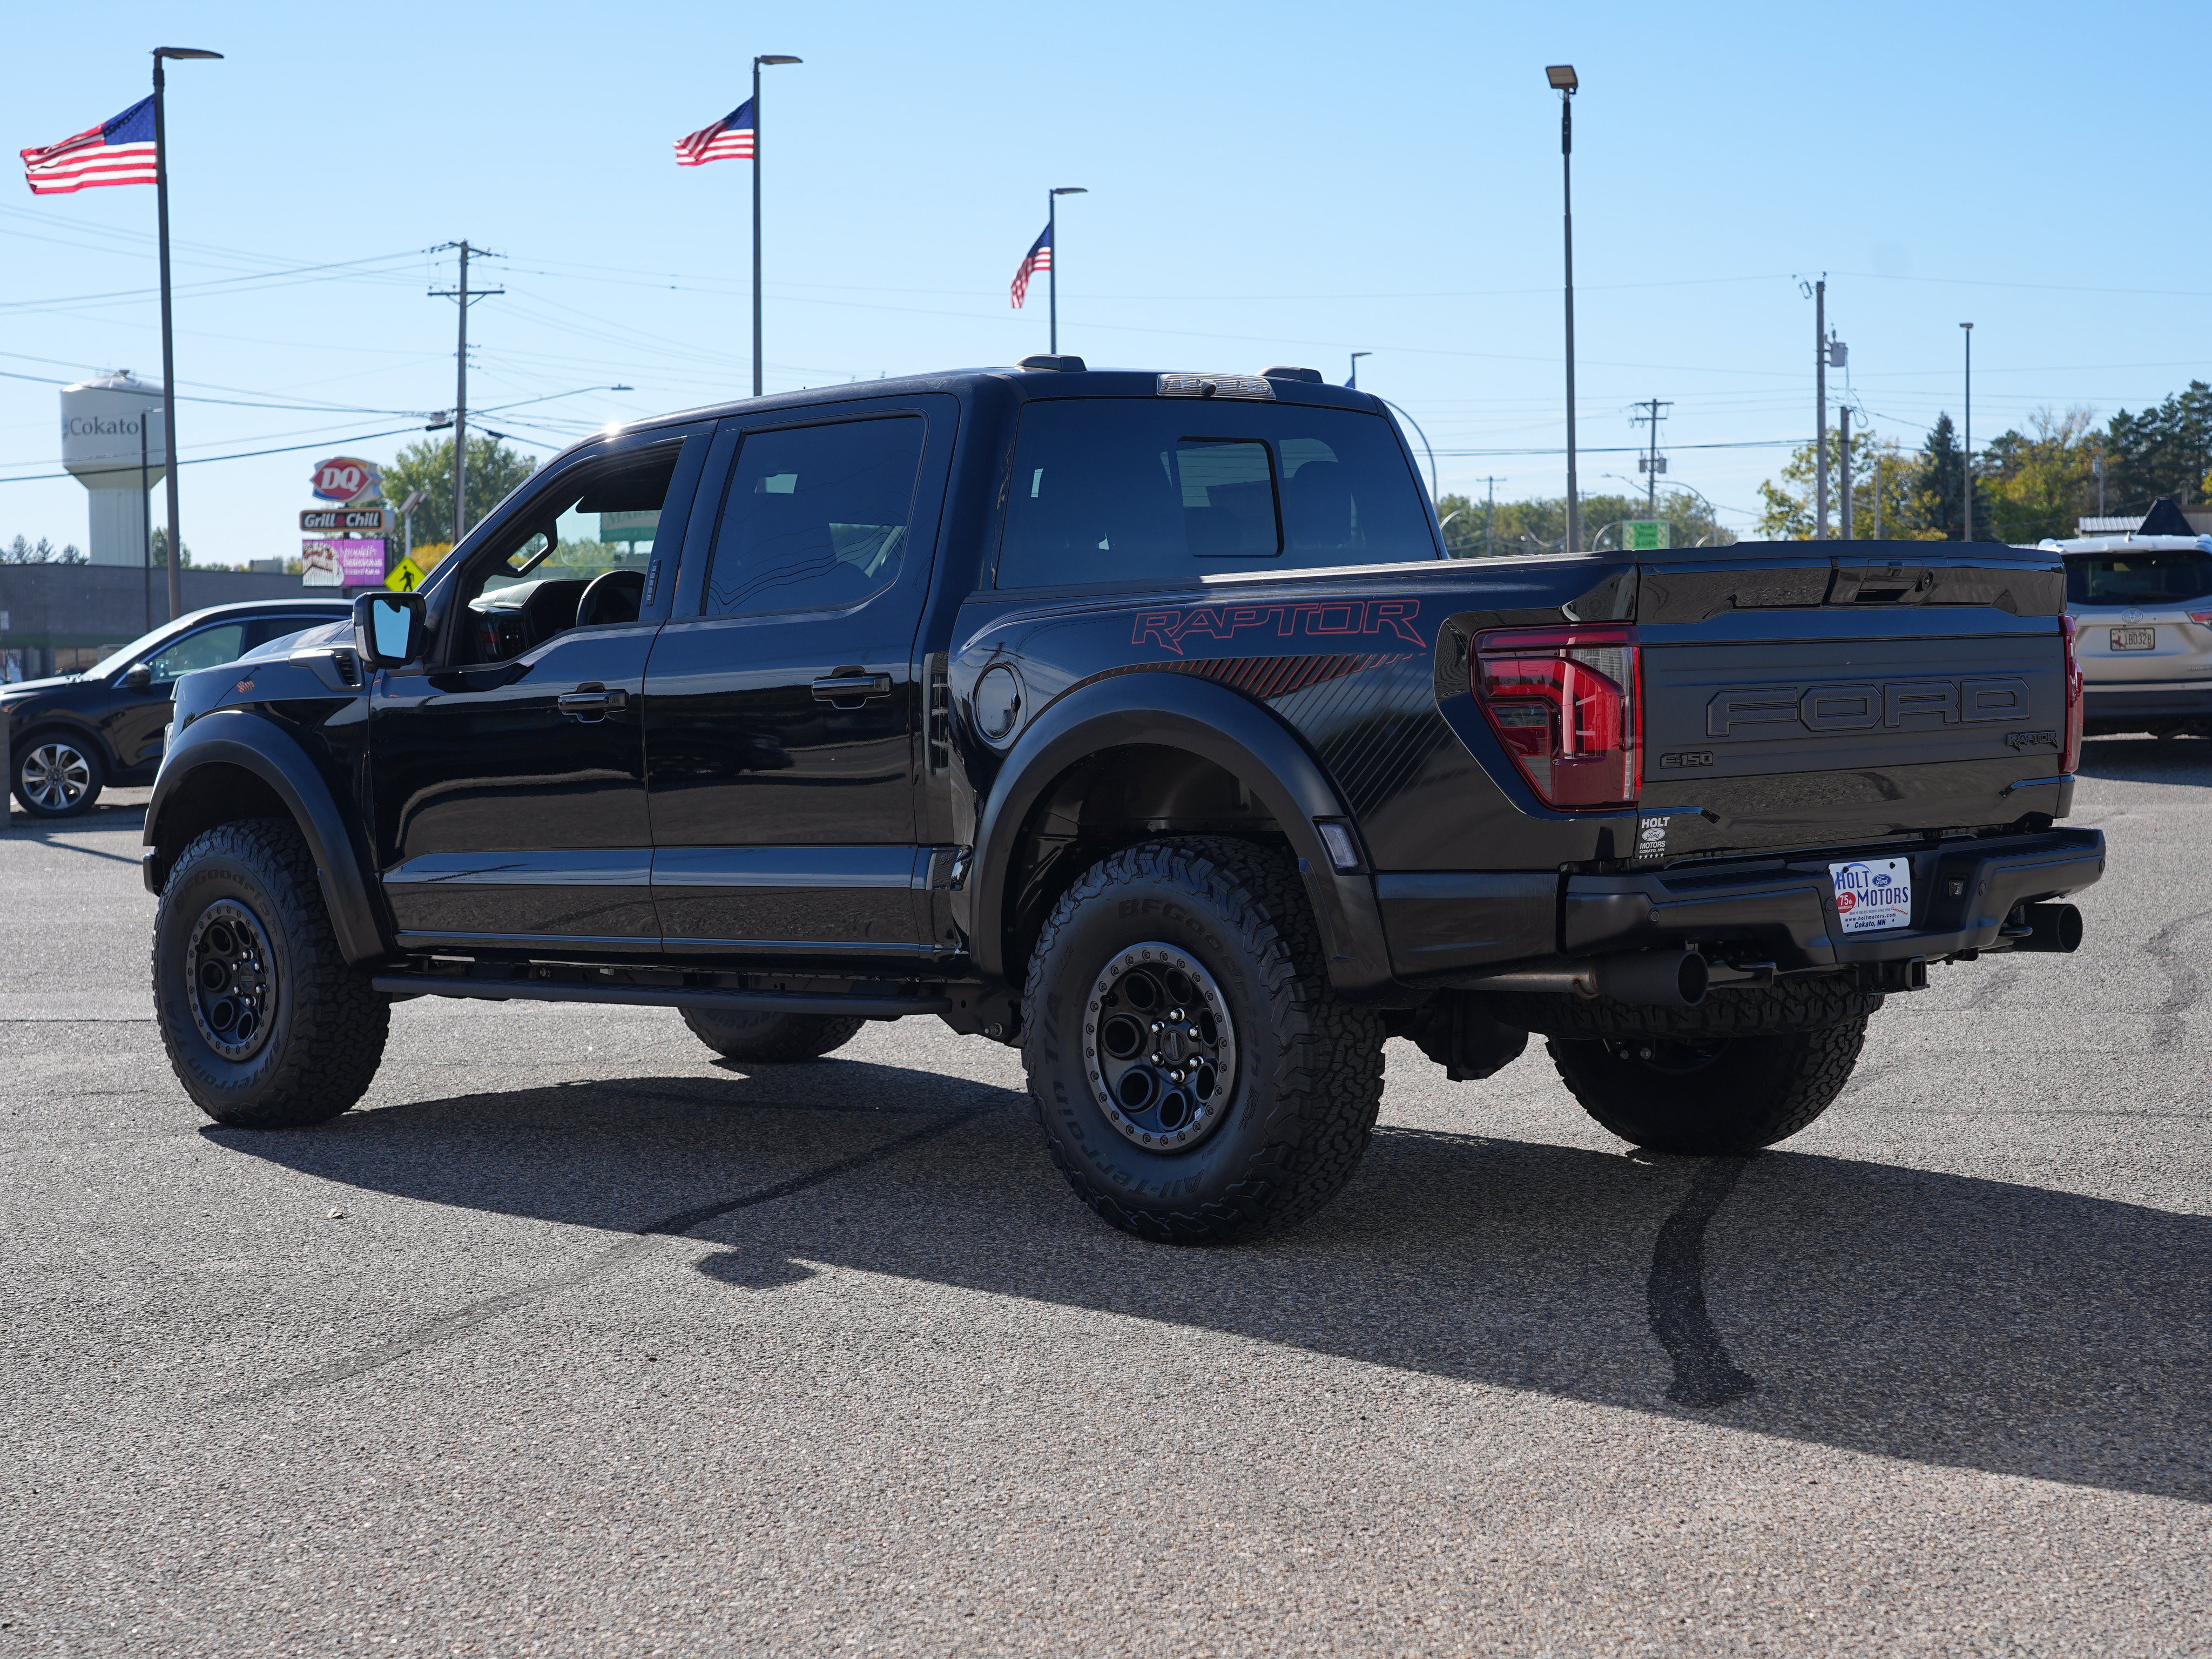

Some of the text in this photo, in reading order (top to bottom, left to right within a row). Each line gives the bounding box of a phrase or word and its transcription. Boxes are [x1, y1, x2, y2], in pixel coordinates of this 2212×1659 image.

[70, 416, 138, 436] Cokato
[321, 467, 360, 492] DQ
[304, 513, 335, 528] Grill
[346, 512, 379, 527] Chill
[1132, 599, 1426, 655] RAPTOR
[1707, 677, 2030, 737] FORD
[2006, 730, 2059, 752] RAPTOR
[1660, 751, 1713, 769] F-150
[1642, 817, 1670, 828] HOLT
[1647, 830, 1661, 839] Ford
[1640, 840, 1665, 849] MOTORS
[1836, 871, 1869, 889] HOLT
[1876, 875, 1889, 885] Ford
[1839, 894, 1853, 906] 75th
[1857, 887, 1908, 908] MOTORS
[1845, 913, 1896, 922] www.holtmotors.com
[1118, 898, 1260, 1078] BFGoodrich
[1043, 992, 1205, 1199] All-Terrain T/A
